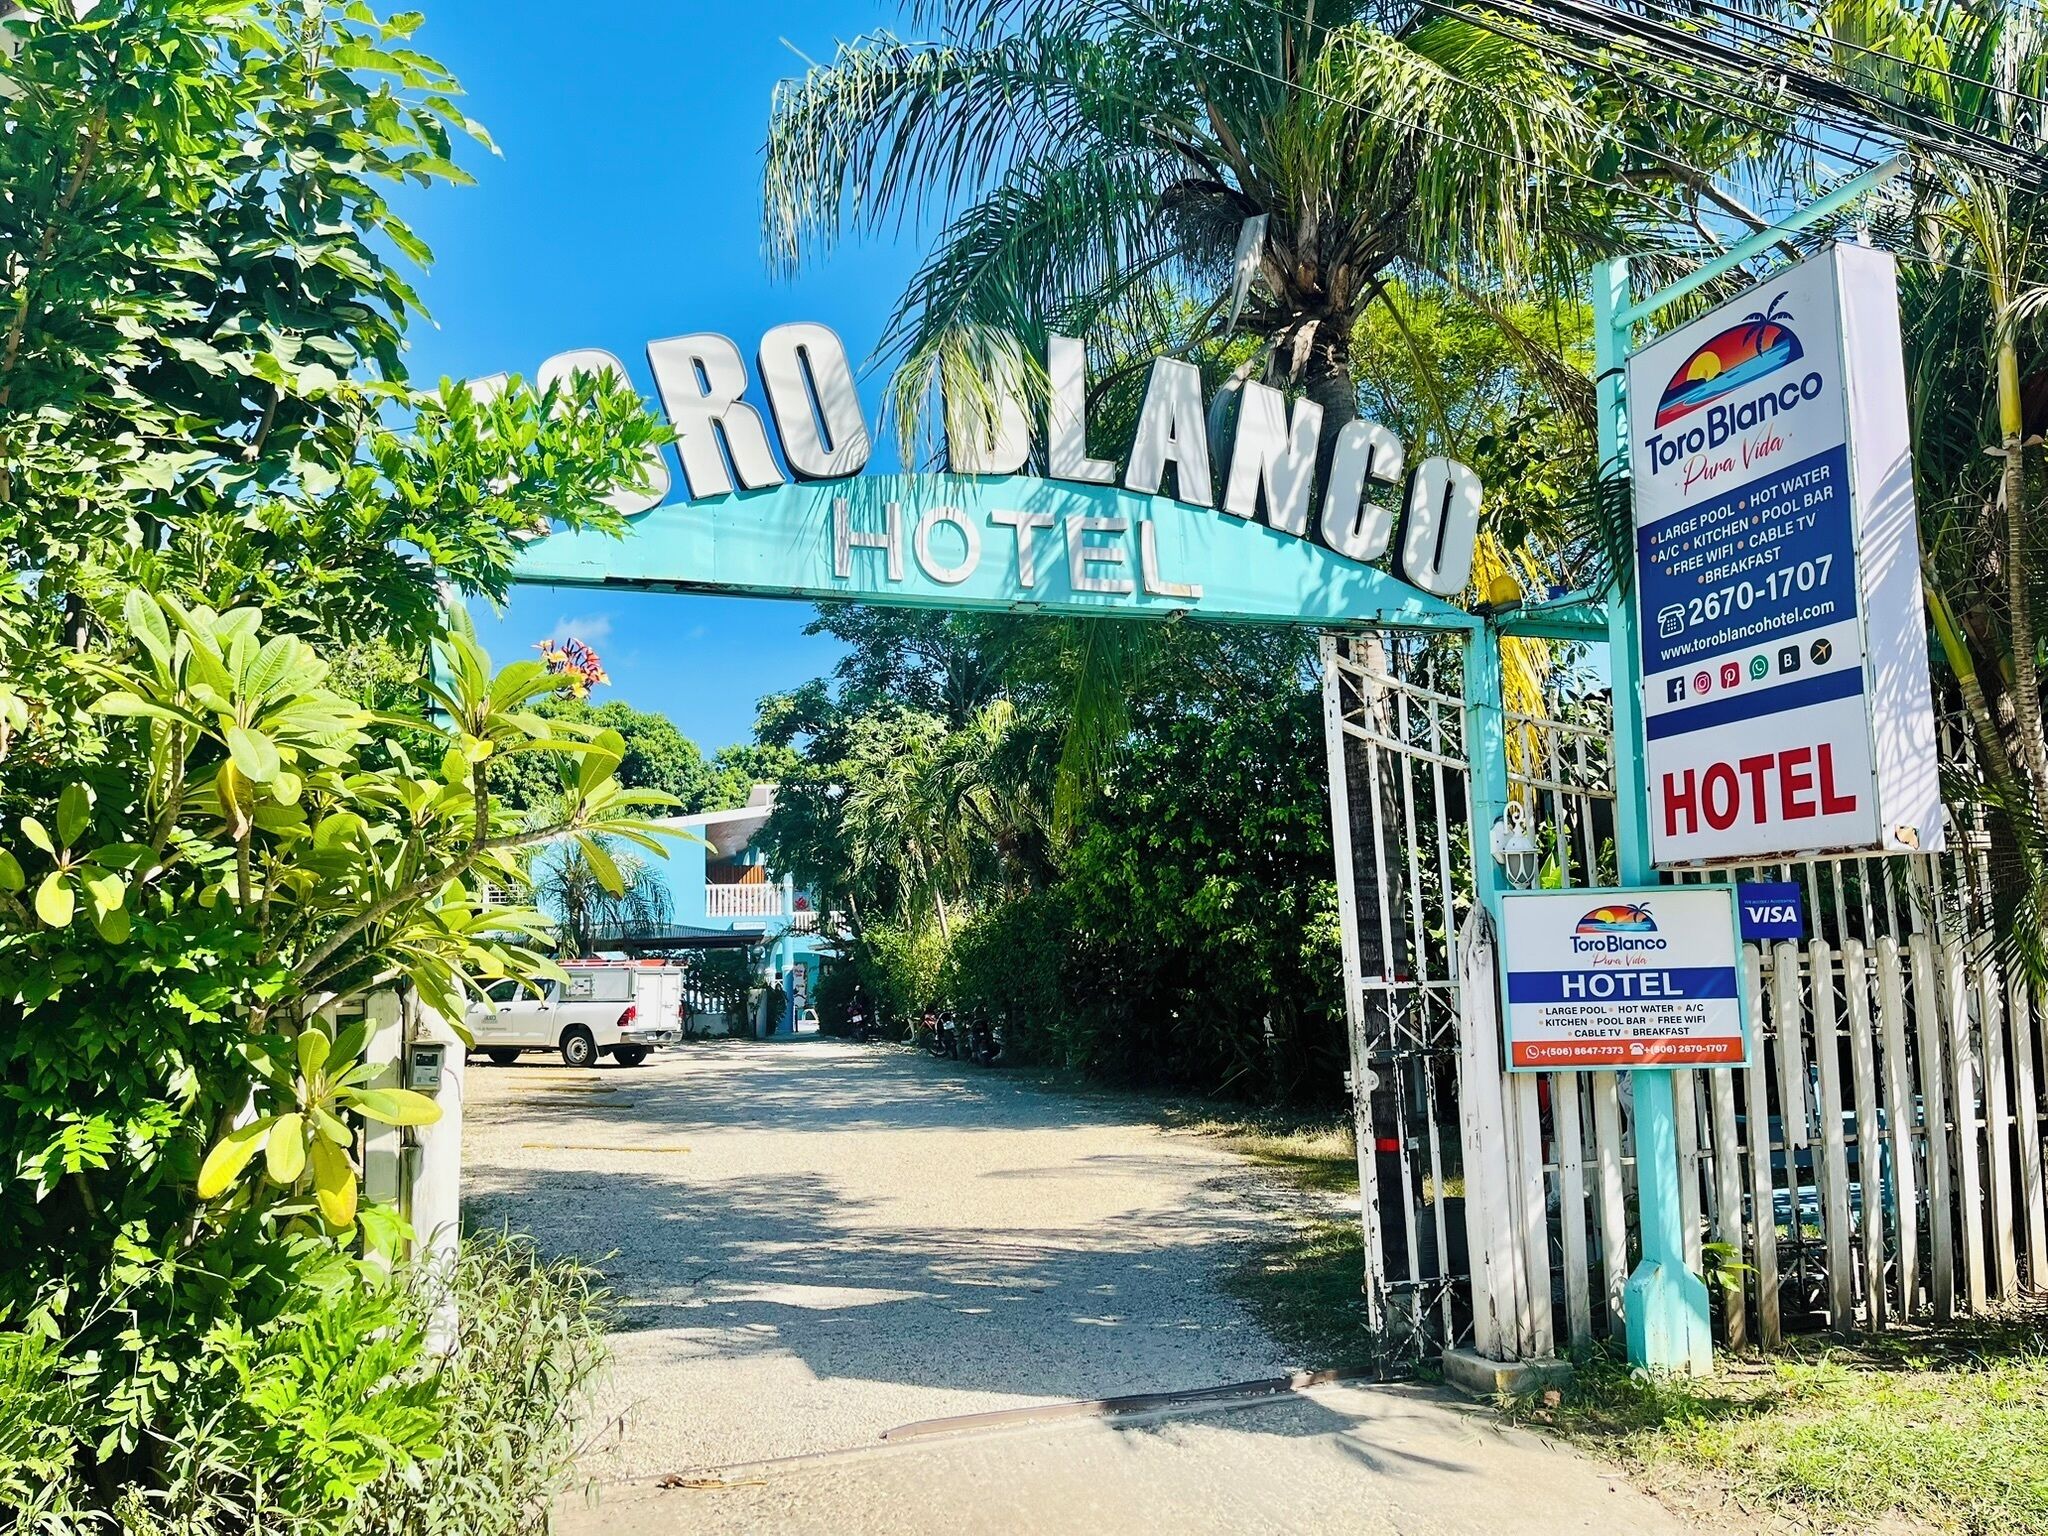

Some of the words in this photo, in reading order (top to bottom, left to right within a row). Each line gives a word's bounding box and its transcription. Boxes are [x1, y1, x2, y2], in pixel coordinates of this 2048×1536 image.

[404, 322, 872, 538] ORO
[948, 324, 1484, 596] BLANCO
[1684, 453, 1736, 496] Pura
[1743, 422, 1784, 469] Vida
[1657, 544, 1680, 563] A/C
[1693, 517, 1749, 549] KITCHEN
[1762, 499, 1800, 523] POOL
[1804, 485, 1833, 508] BAR
[1658, 518, 1697, 544] LARGE
[1700, 504, 1735, 527] POOL
[1750, 485, 1778, 507] HOT
[1781, 465, 1830, 495] WATER
[833, 496, 1204, 599] HOTEL
[1673, 554, 1704, 576] FREE
[1706, 543, 1733, 564] WIFI
[1749, 521, 1794, 548] CABLE
[1796, 512, 1816, 531] TV
[1705, 546, 1781, 584] BREAKFAST
[1688, 554, 1833, 626] 2670-1707
[1661, 600, 1835, 661] www.toroblancohotel.com
[1662, 743, 1857, 837] HOTEL
[1744, 906, 1797, 923] VISA
[1562, 972, 1684, 998] HOTEL
[1592, 953, 1622, 967] Pura
[1625, 952, 1648, 966] Vida
[1545, 1007, 1577, 1015] LARGE
[1580, 1006, 1607, 1015] POOL
[1618, 1005, 1638, 1013] HOT
[1640, 1005, 1674, 1013] WATER
[1685, 1004, 1704, 1012] A/C
[1545, 1018, 1588, 1026] KITCHEN
[1597, 1017, 1624, 1025] POOL
[1657, 1016, 1682, 1024] FREE
[1684, 1015, 1706, 1023] WIFI
[1574, 1029, 1606, 1037] CABLE
[1633, 1027, 1690, 1036] BREAKFAST
[1574, 1046, 1624, 1055] 8647-7373
[1678, 1044, 1728, 1053] 2670-1707
